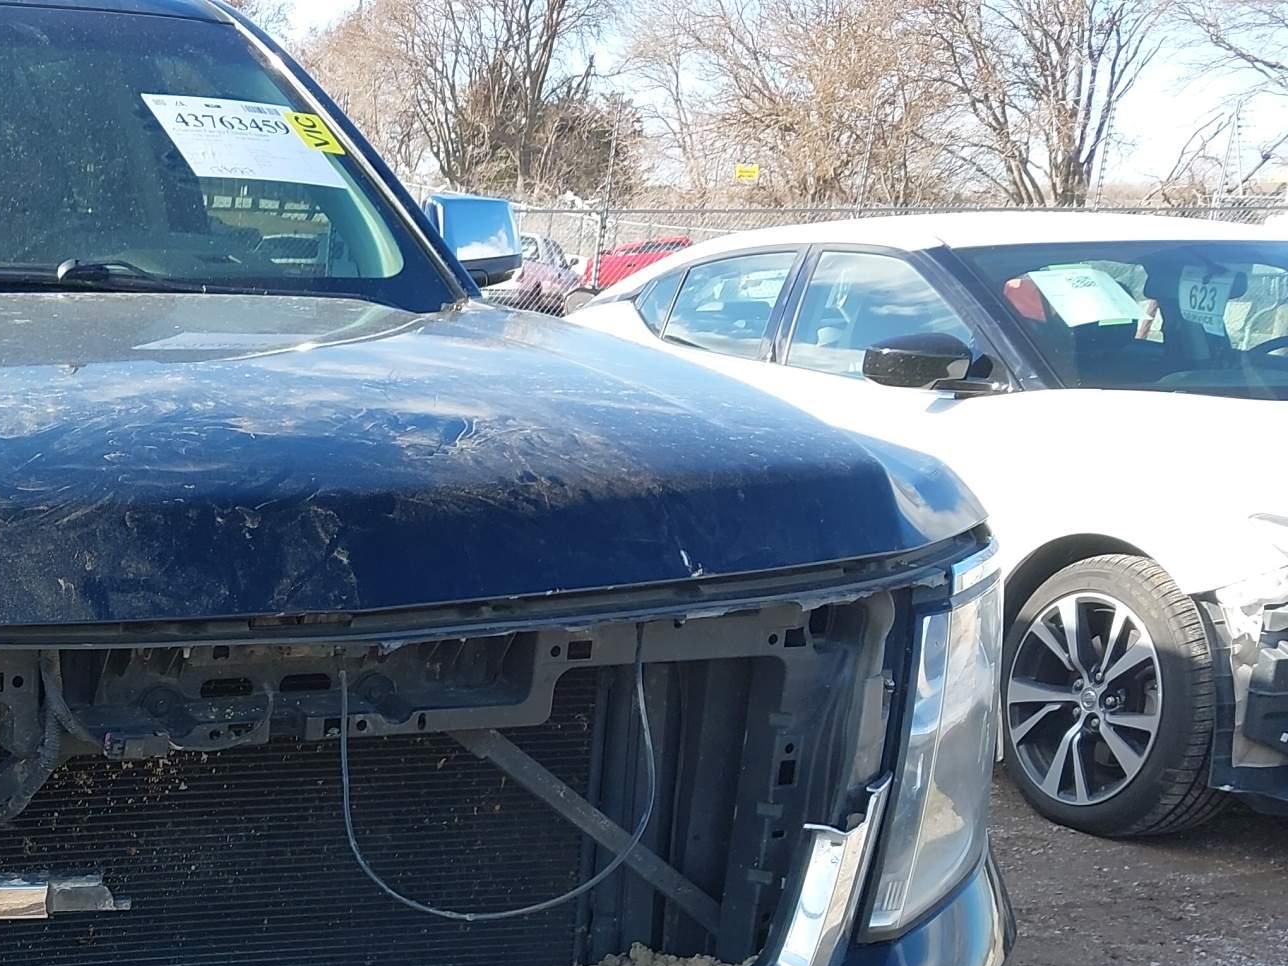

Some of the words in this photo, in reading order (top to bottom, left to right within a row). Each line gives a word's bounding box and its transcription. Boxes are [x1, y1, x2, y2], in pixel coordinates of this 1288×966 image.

[175, 112, 290, 135] 43763459
[294, 115, 330, 147] VIC
[1189, 284, 1217, 312] 623
